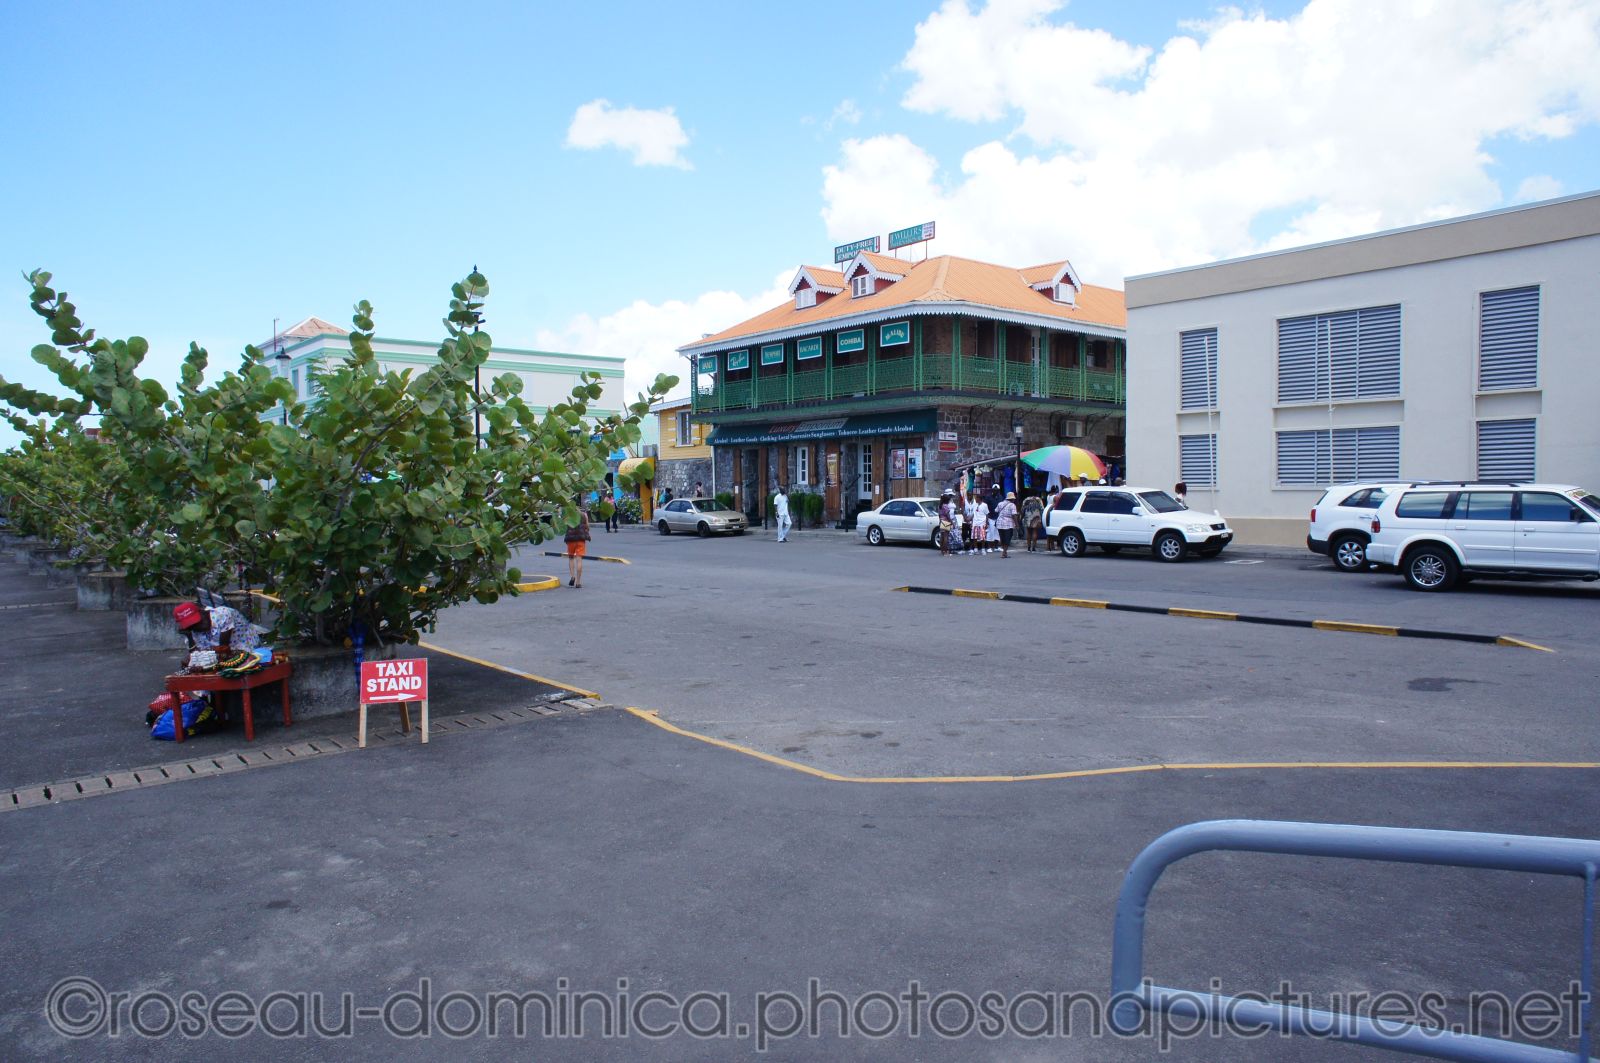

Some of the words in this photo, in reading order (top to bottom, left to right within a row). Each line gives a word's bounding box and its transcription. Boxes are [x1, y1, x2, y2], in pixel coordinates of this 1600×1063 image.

[836, 239, 874, 254] DUTY-FREE
[840, 337, 861, 346] COHIBA
[893, 424, 914, 432] Alcohol
[376, 661, 414, 676] TAXI
[366, 676, 422, 692] STAND
